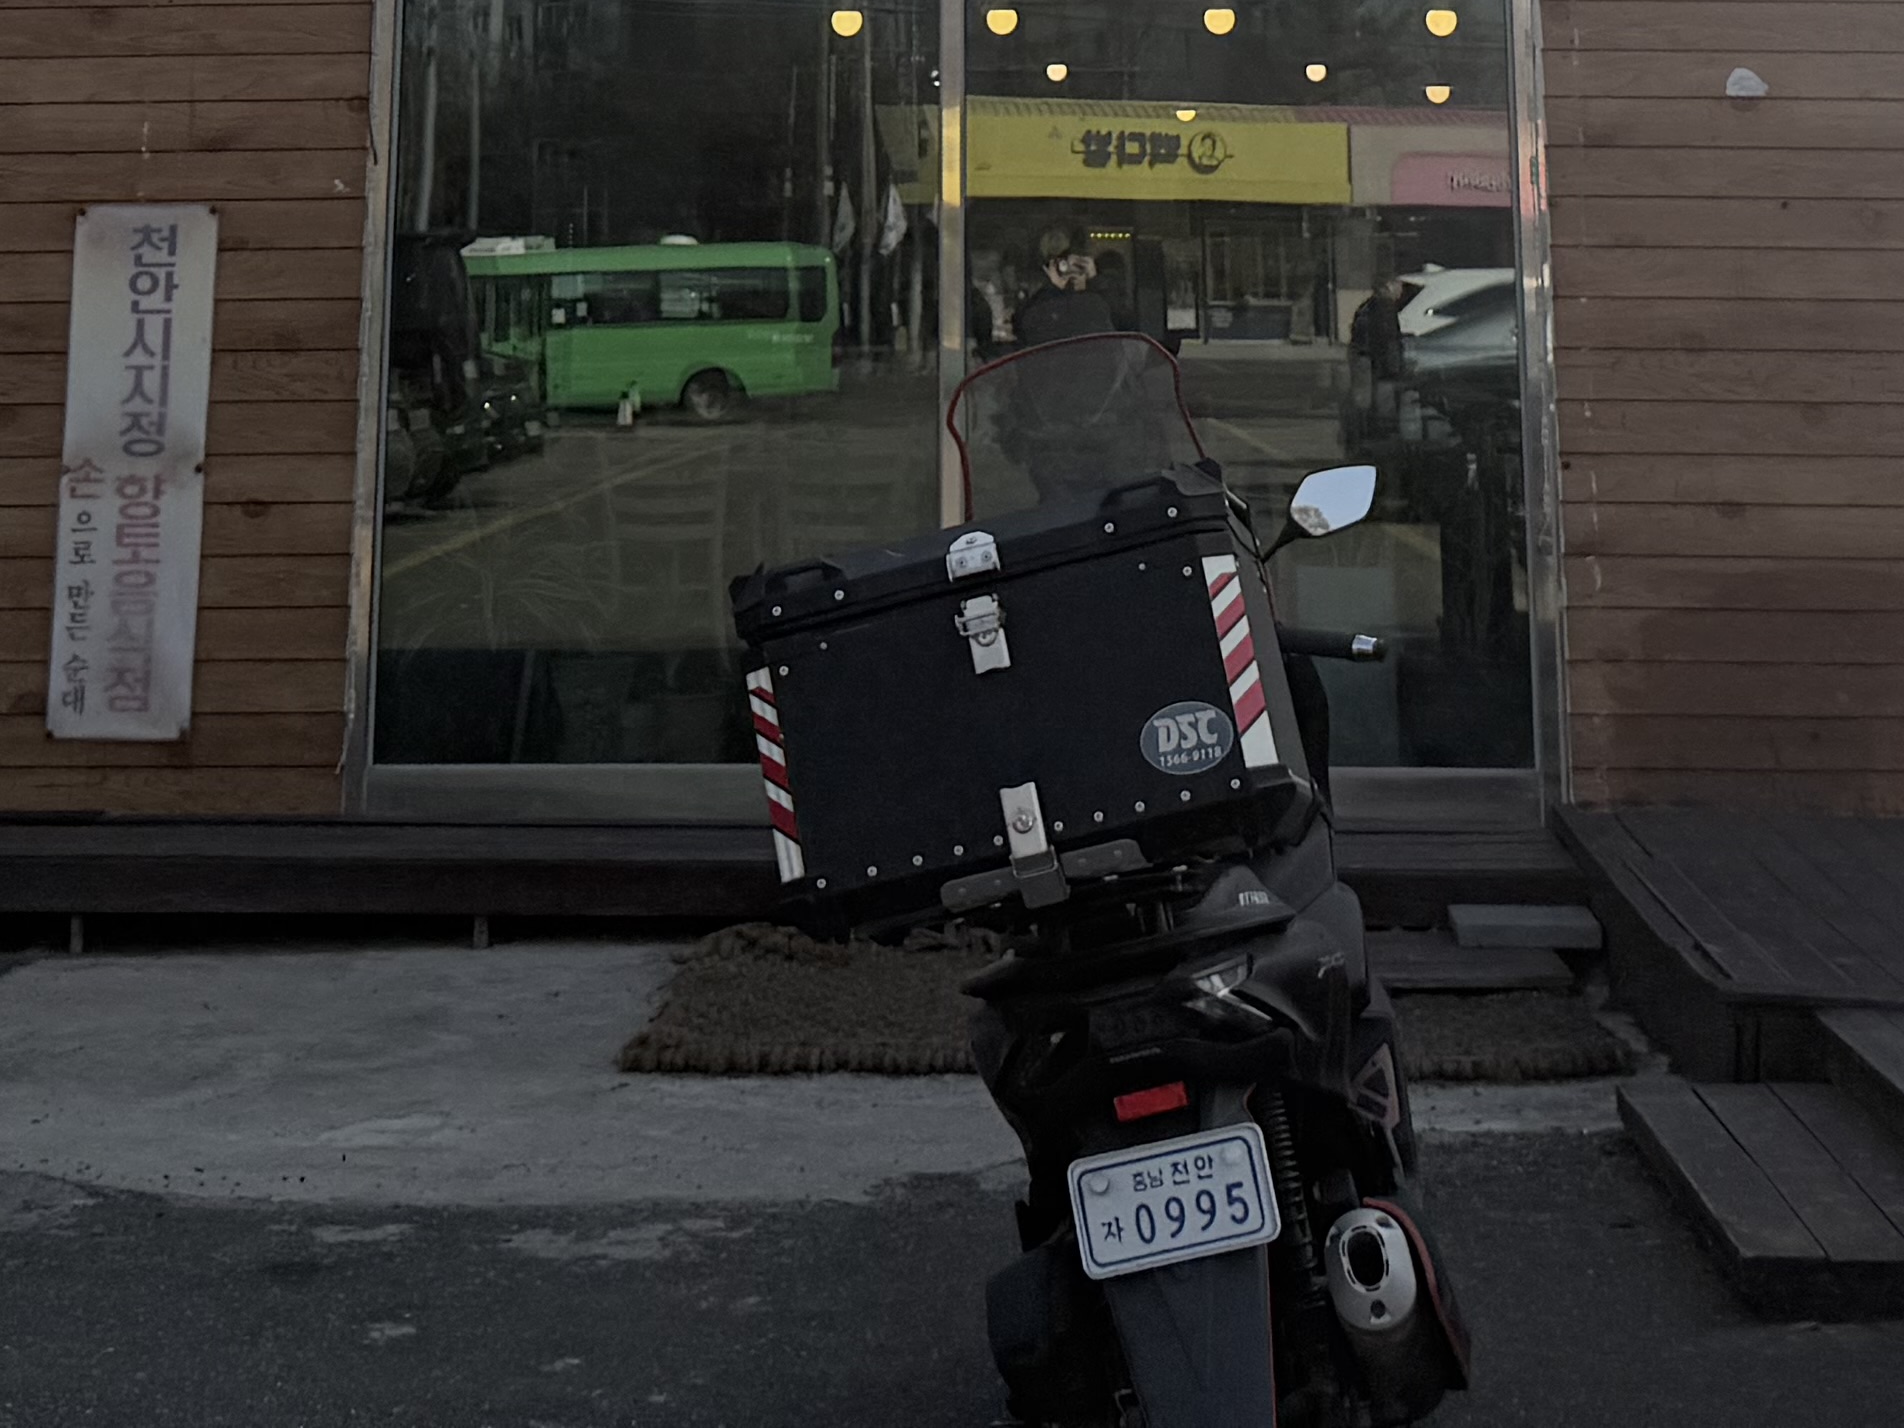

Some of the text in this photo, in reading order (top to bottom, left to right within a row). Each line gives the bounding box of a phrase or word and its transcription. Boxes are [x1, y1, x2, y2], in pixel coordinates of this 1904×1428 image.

[104, 223, 180, 713] 천안시지정 향토음식점
[61, 456, 105, 717] 손으로 만든 순대
[1152, 708, 1218, 753] DSC
[1132, 1153, 1214, 1193] 충남 천안
[1101, 1180, 1250, 1244] 자 0995
